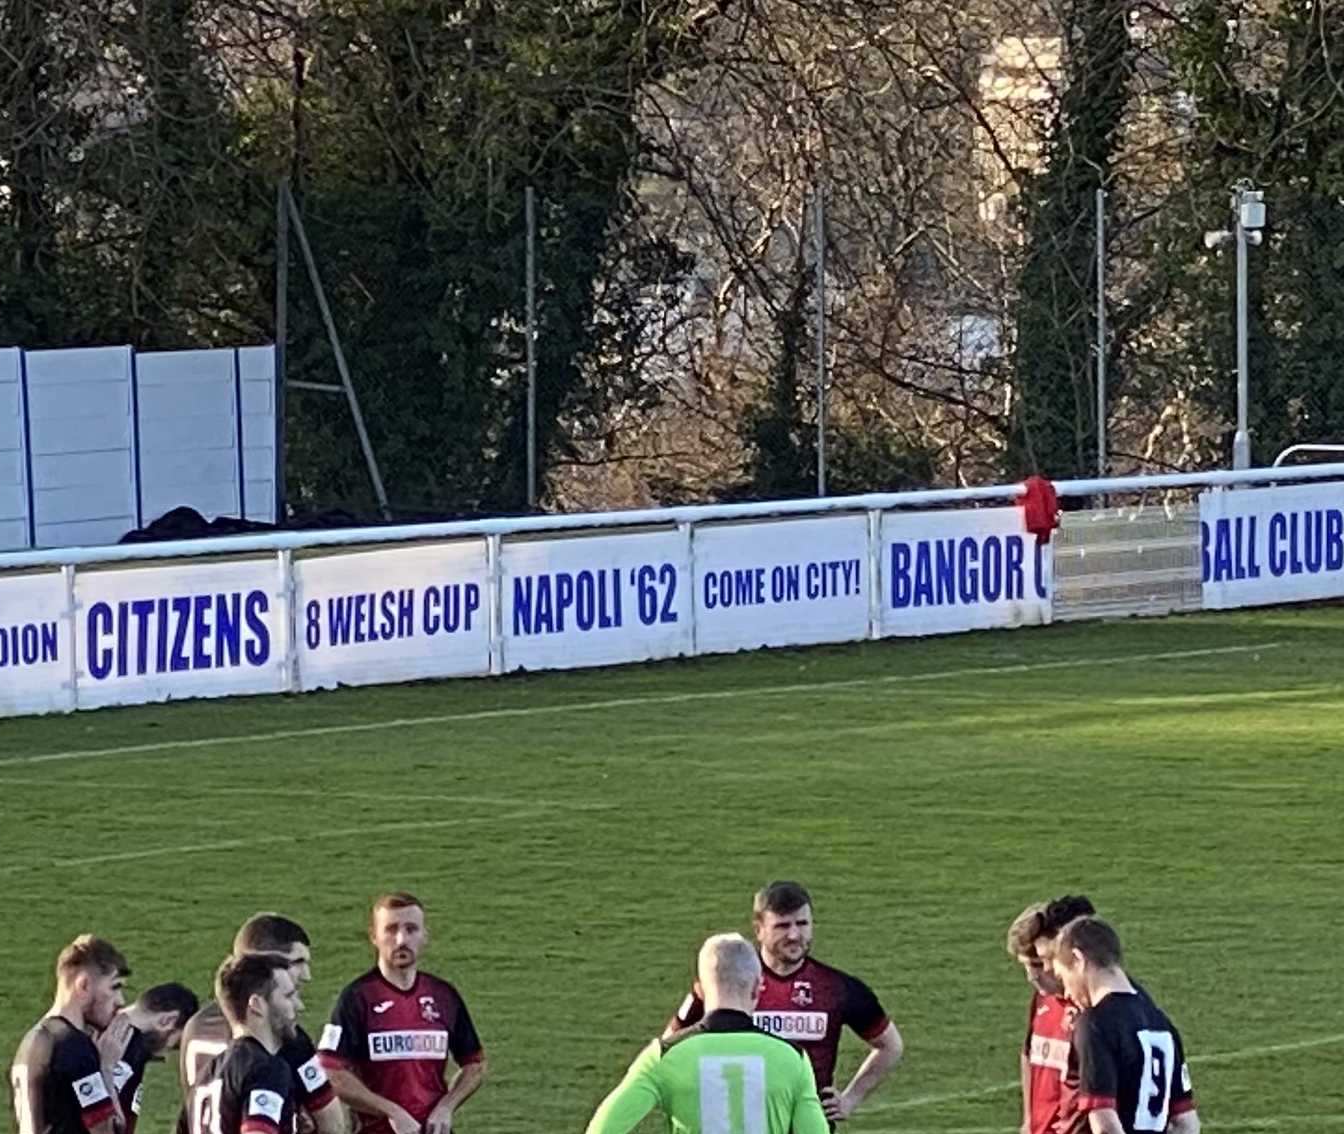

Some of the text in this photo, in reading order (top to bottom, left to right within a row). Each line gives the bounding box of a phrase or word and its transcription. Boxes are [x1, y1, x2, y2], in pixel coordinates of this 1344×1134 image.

[890, 535, 1024, 610] BANGOR
[1268, 508, 1344, 578] CLUB
[306, 583, 480, 649] 8 WELSH CUP
[512, 568, 623, 637] NAPOLI
[703, 558, 861, 610] COME ON CITY!
[87, 589, 270, 680] CITIZENS
